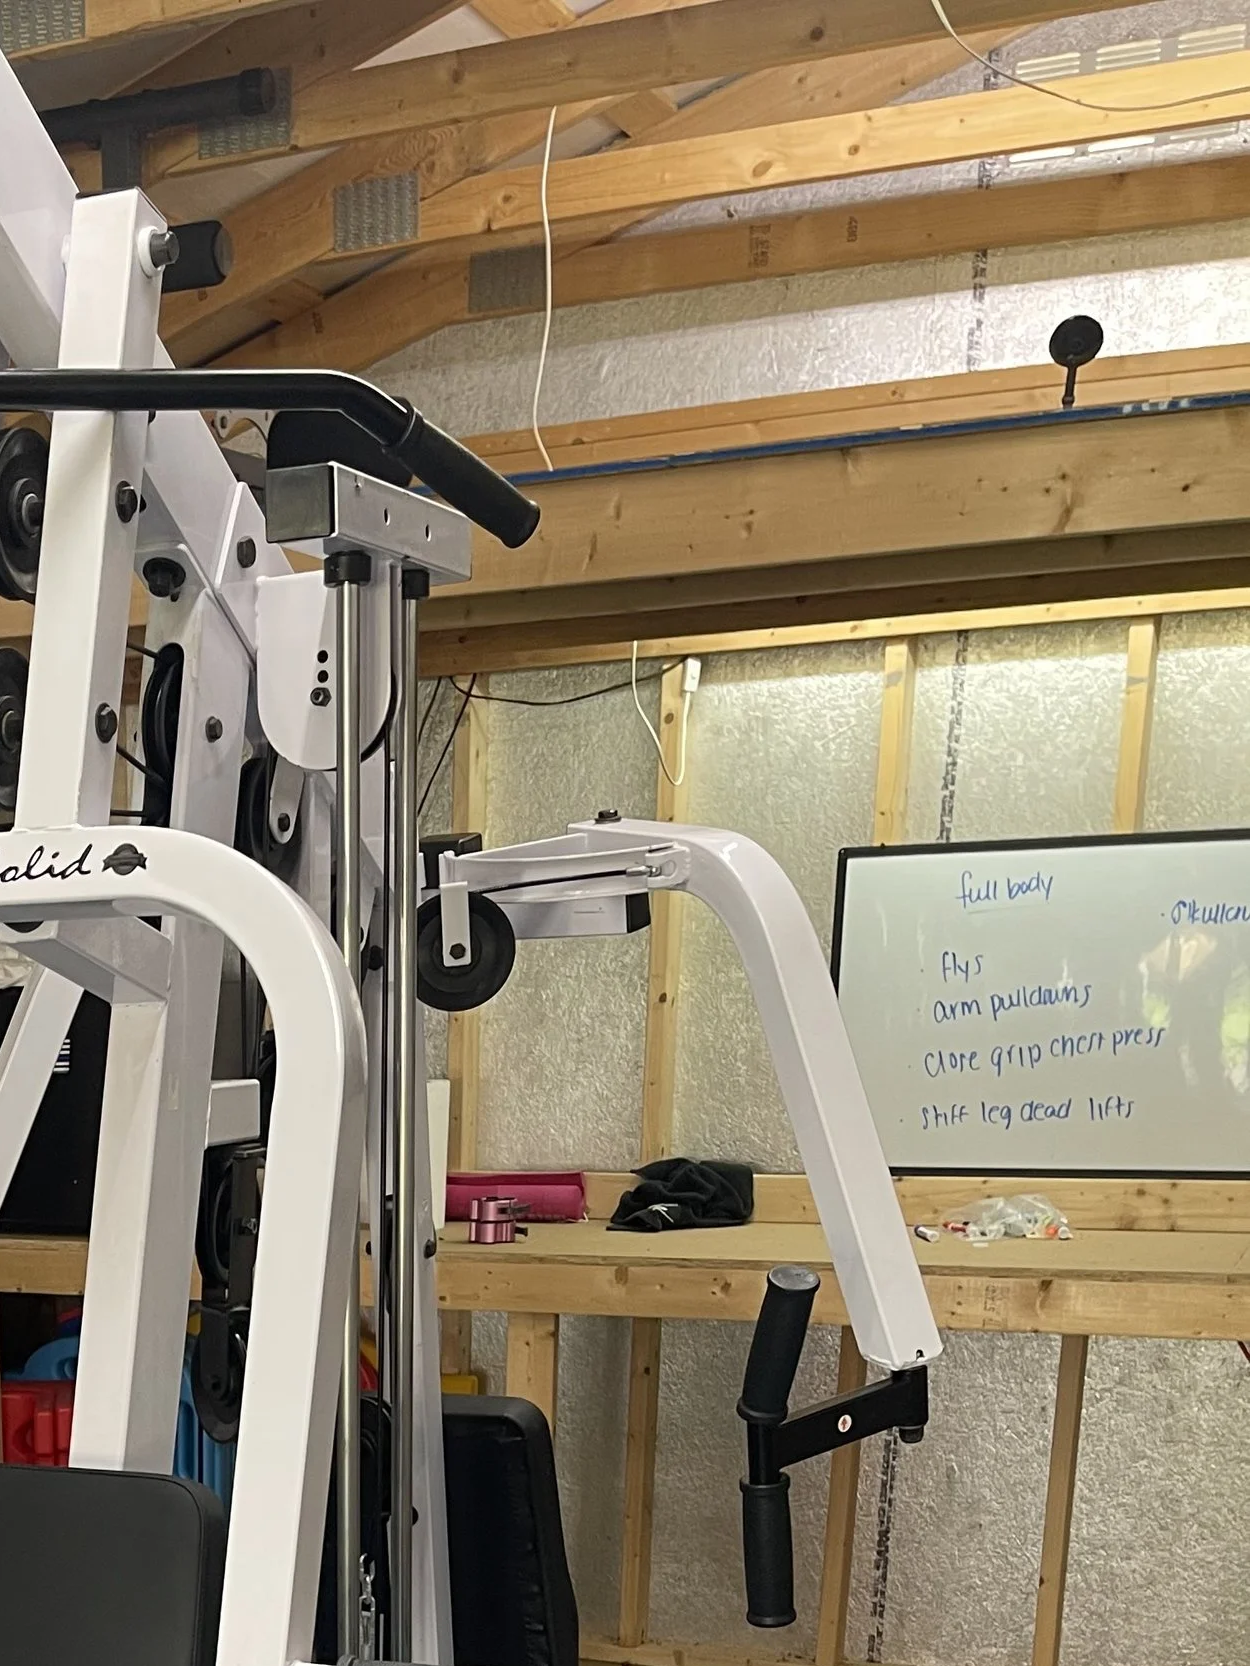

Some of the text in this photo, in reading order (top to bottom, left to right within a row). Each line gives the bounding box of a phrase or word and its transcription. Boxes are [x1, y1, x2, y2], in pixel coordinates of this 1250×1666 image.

[955, 870, 1053, 908] full body
[941, 950, 984, 983] flys
[933, 999, 982, 1023] arm
[991, 1044, 1042, 1077] grip
[1112, 1027, 1166, 1056] press
[981, 1101, 1012, 1130] leg
[1020, 1098, 1072, 1122] dead
[1089, 1095, 1135, 1121] lifts
